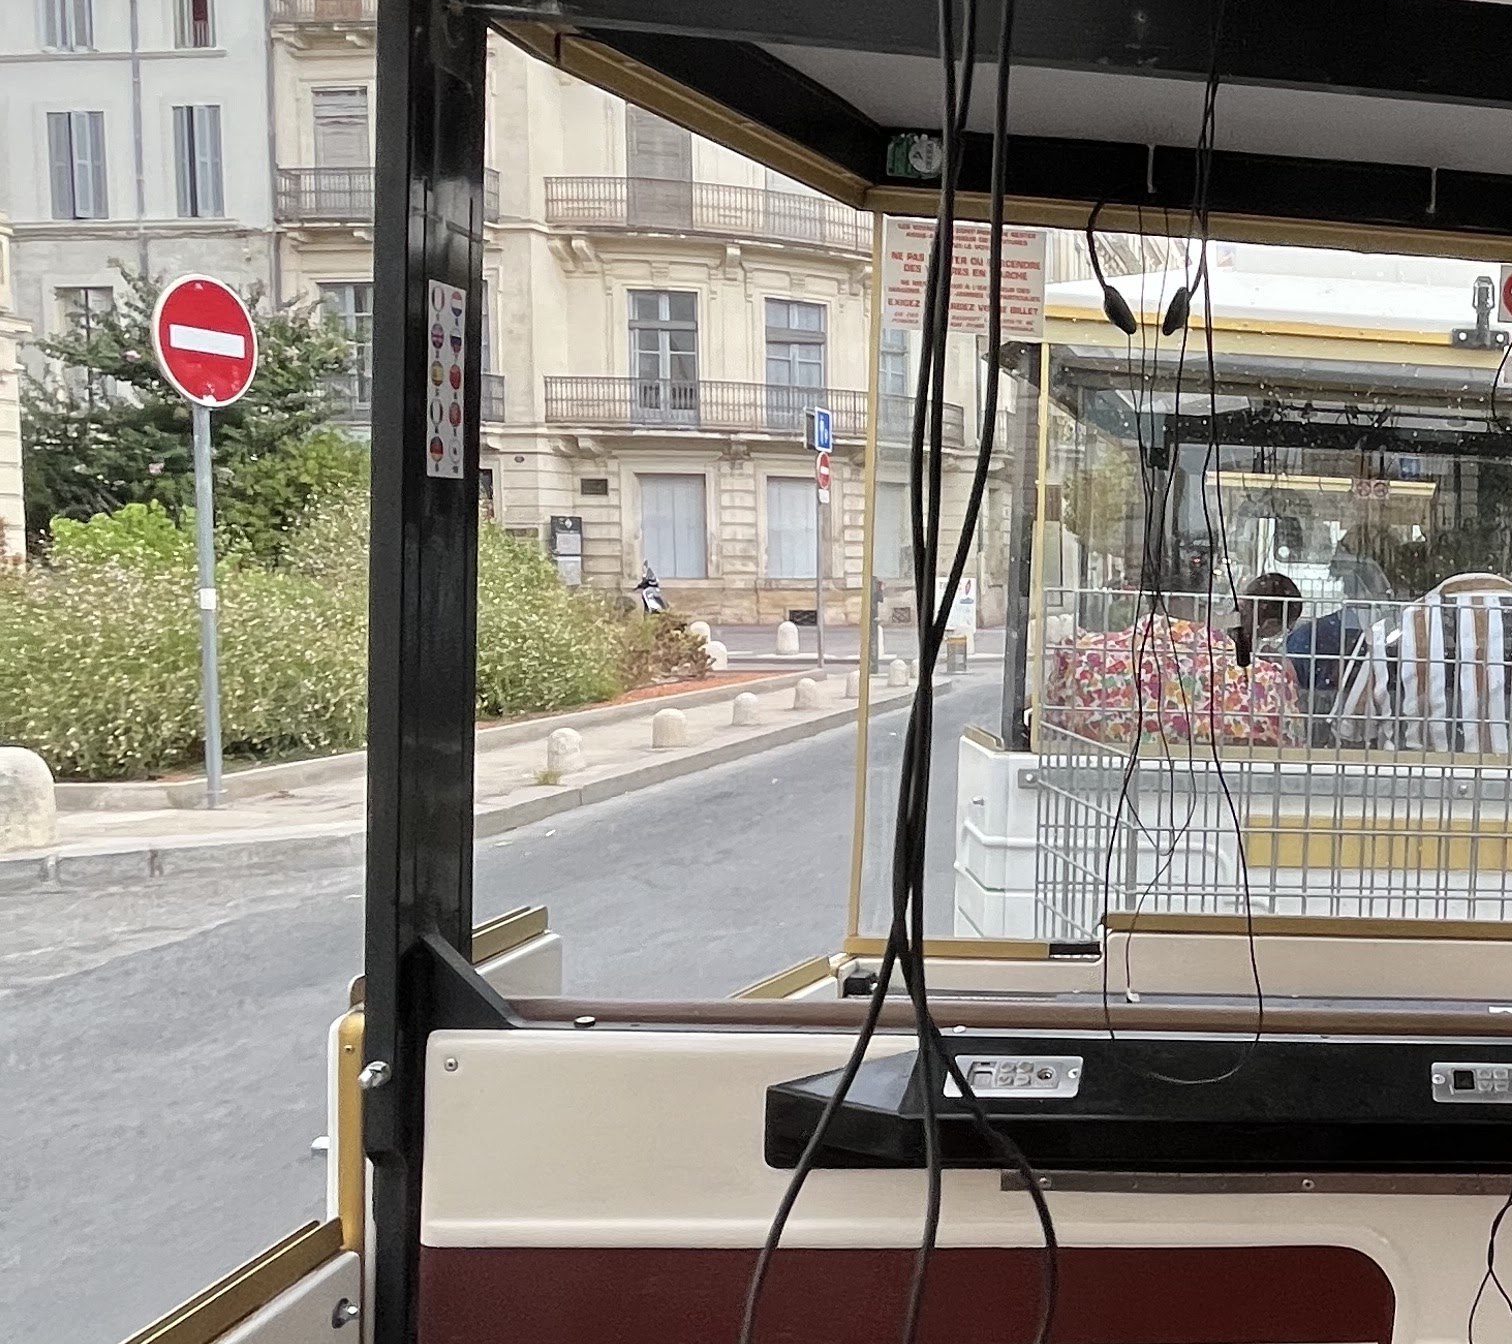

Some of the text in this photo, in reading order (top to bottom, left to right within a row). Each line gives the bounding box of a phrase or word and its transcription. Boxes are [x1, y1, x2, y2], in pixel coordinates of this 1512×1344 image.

[891, 251, 903, 261] NE
[907, 252, 924, 262] PAS
[970, 257, 984, 266] OU
[903, 263, 922, 273] DES
[972, 268, 986, 277] EN
